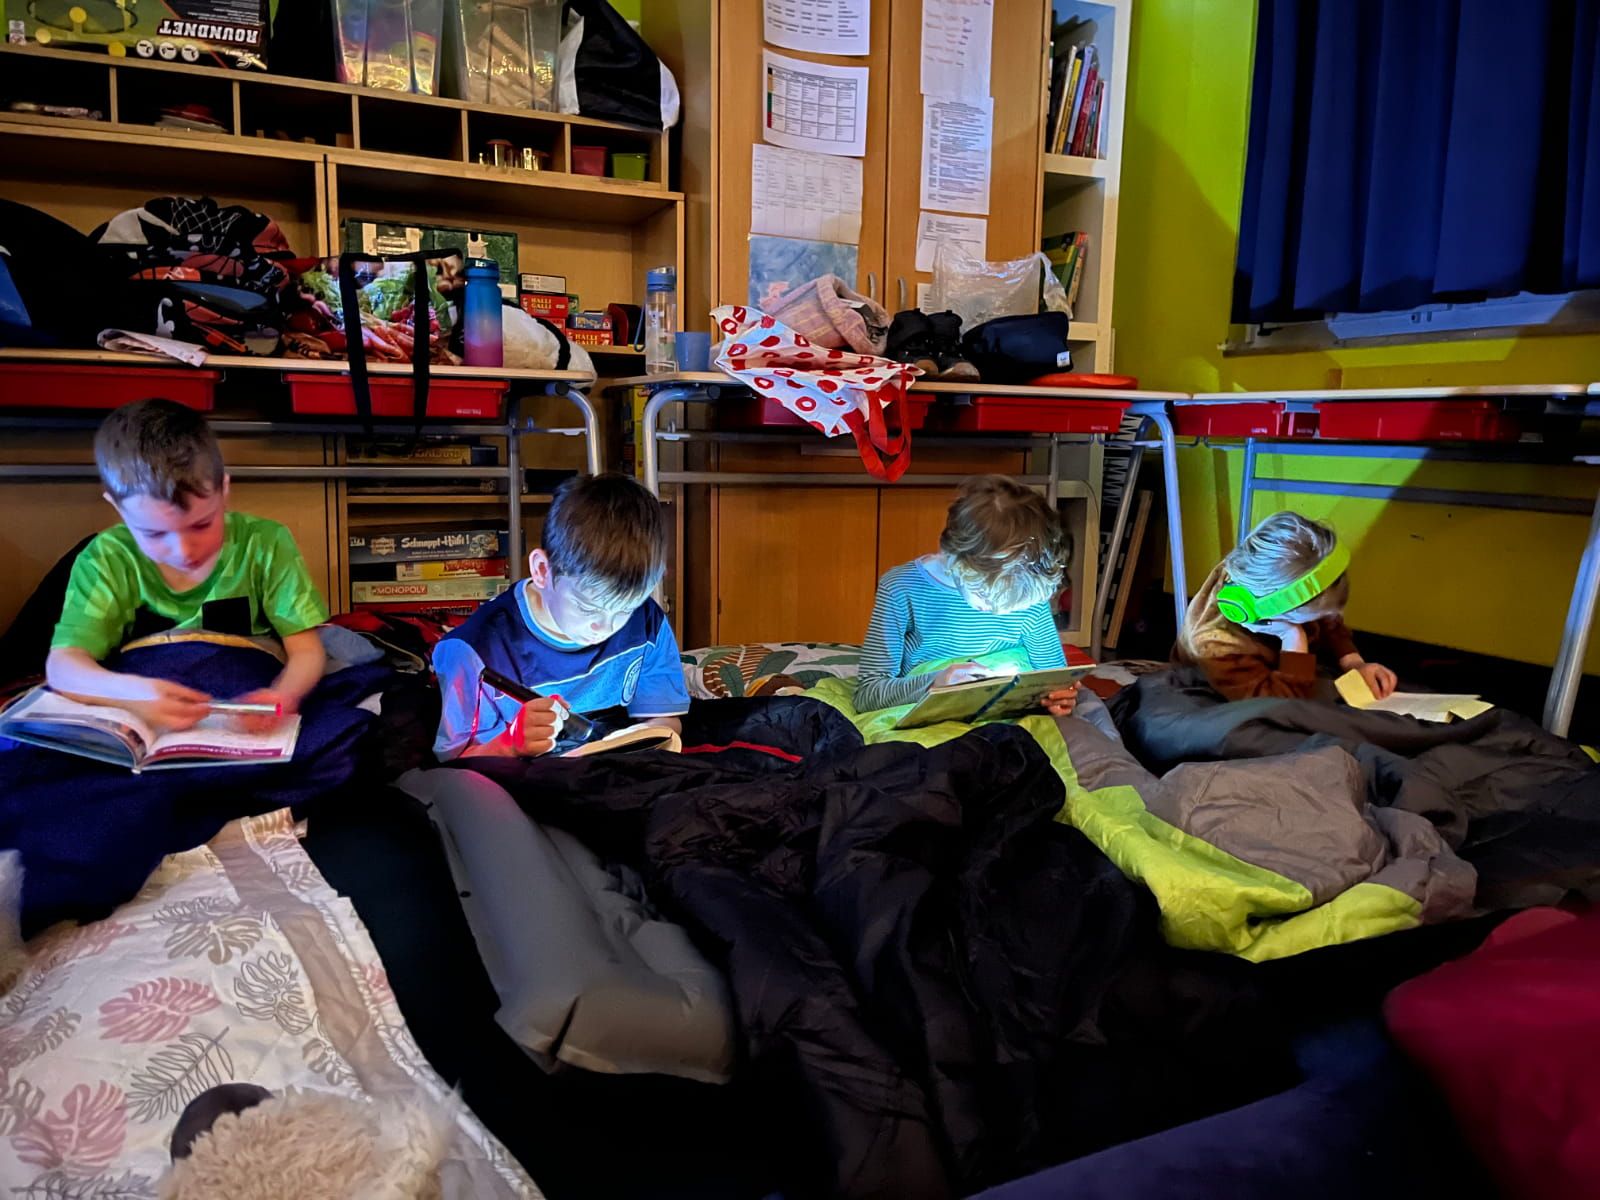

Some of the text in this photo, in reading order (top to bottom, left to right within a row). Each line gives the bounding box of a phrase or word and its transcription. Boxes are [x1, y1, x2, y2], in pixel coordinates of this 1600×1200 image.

[159, 20, 259, 44] ROUNDNET
[575, 333, 598, 341] HALLI
[376, 584, 426, 594] MONOPOLY
